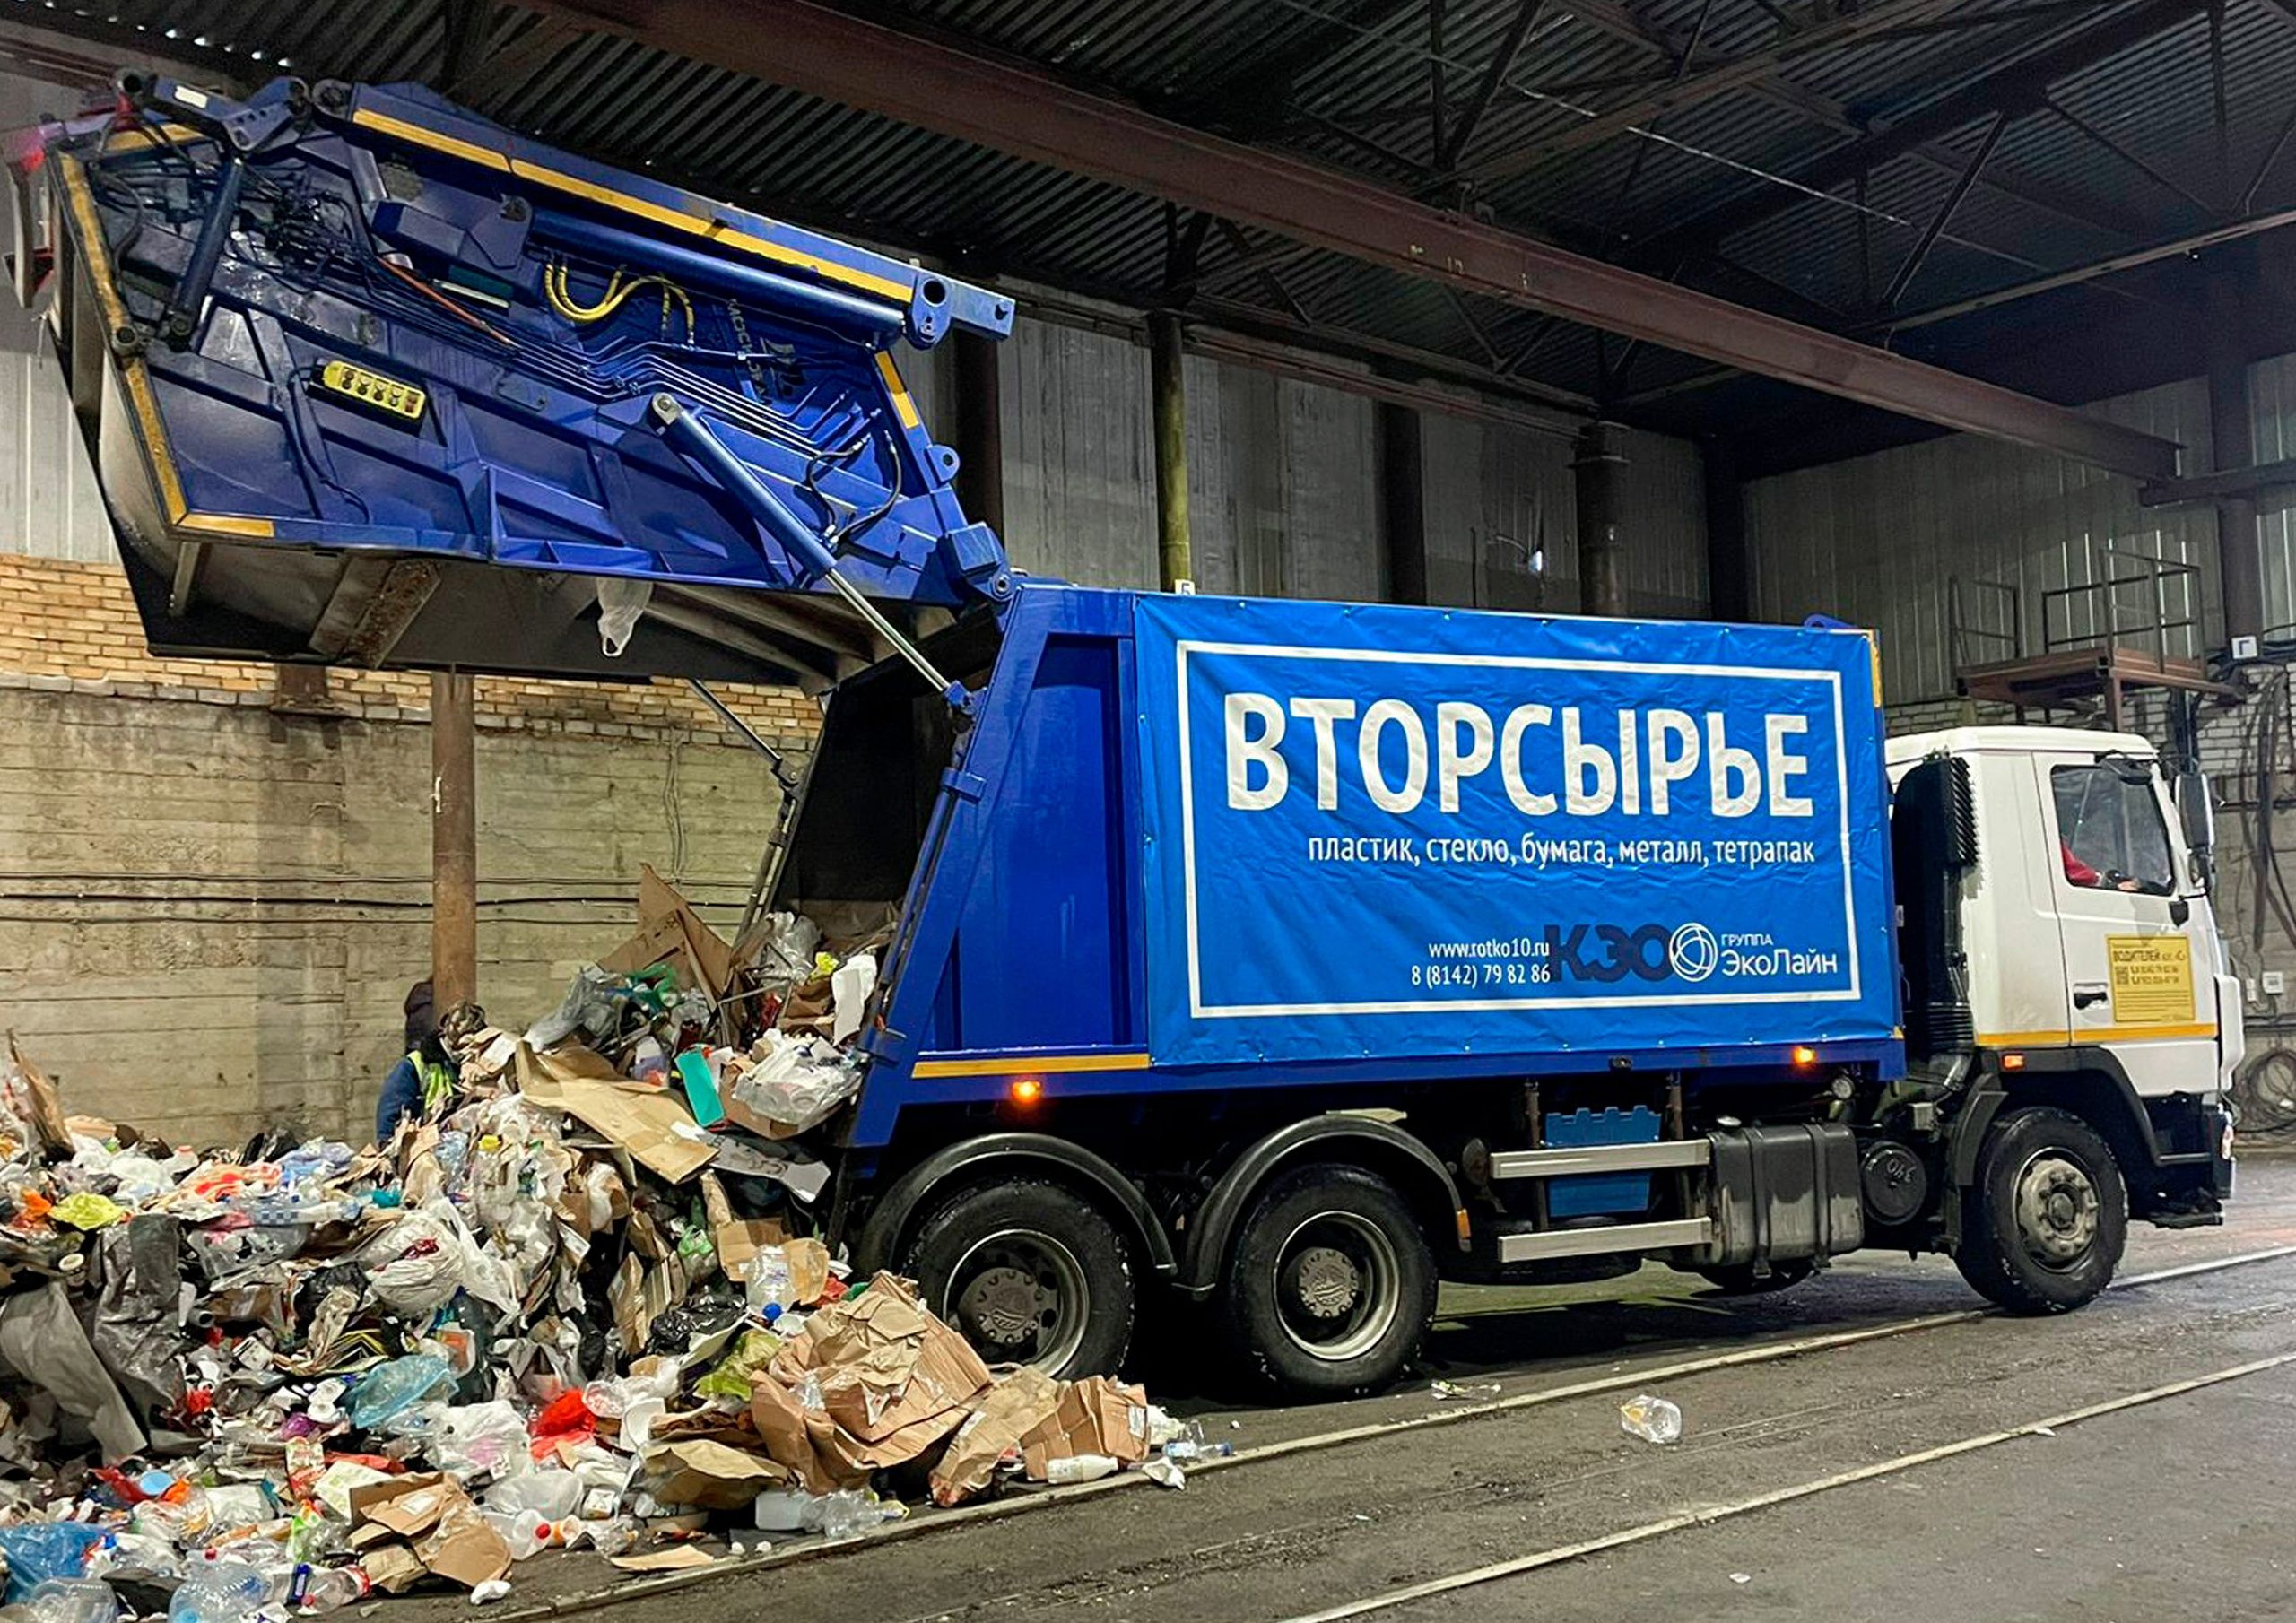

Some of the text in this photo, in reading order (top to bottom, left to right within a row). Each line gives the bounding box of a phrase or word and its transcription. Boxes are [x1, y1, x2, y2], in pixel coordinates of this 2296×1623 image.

[1224, 692, 1813, 817] ВТОРСЫРЬЕ
[1309, 832, 1815, 870] пластик, стекло, бумага, металл, тетрапак
[1428, 937, 1550, 959] www.rotko10.ru
[1721, 933, 1773, 947] ГРУППА
[1721, 948, 1838, 976] ЭкоЛайн
[1411, 963, 1551, 990] 8 (8142) 79 82 86
